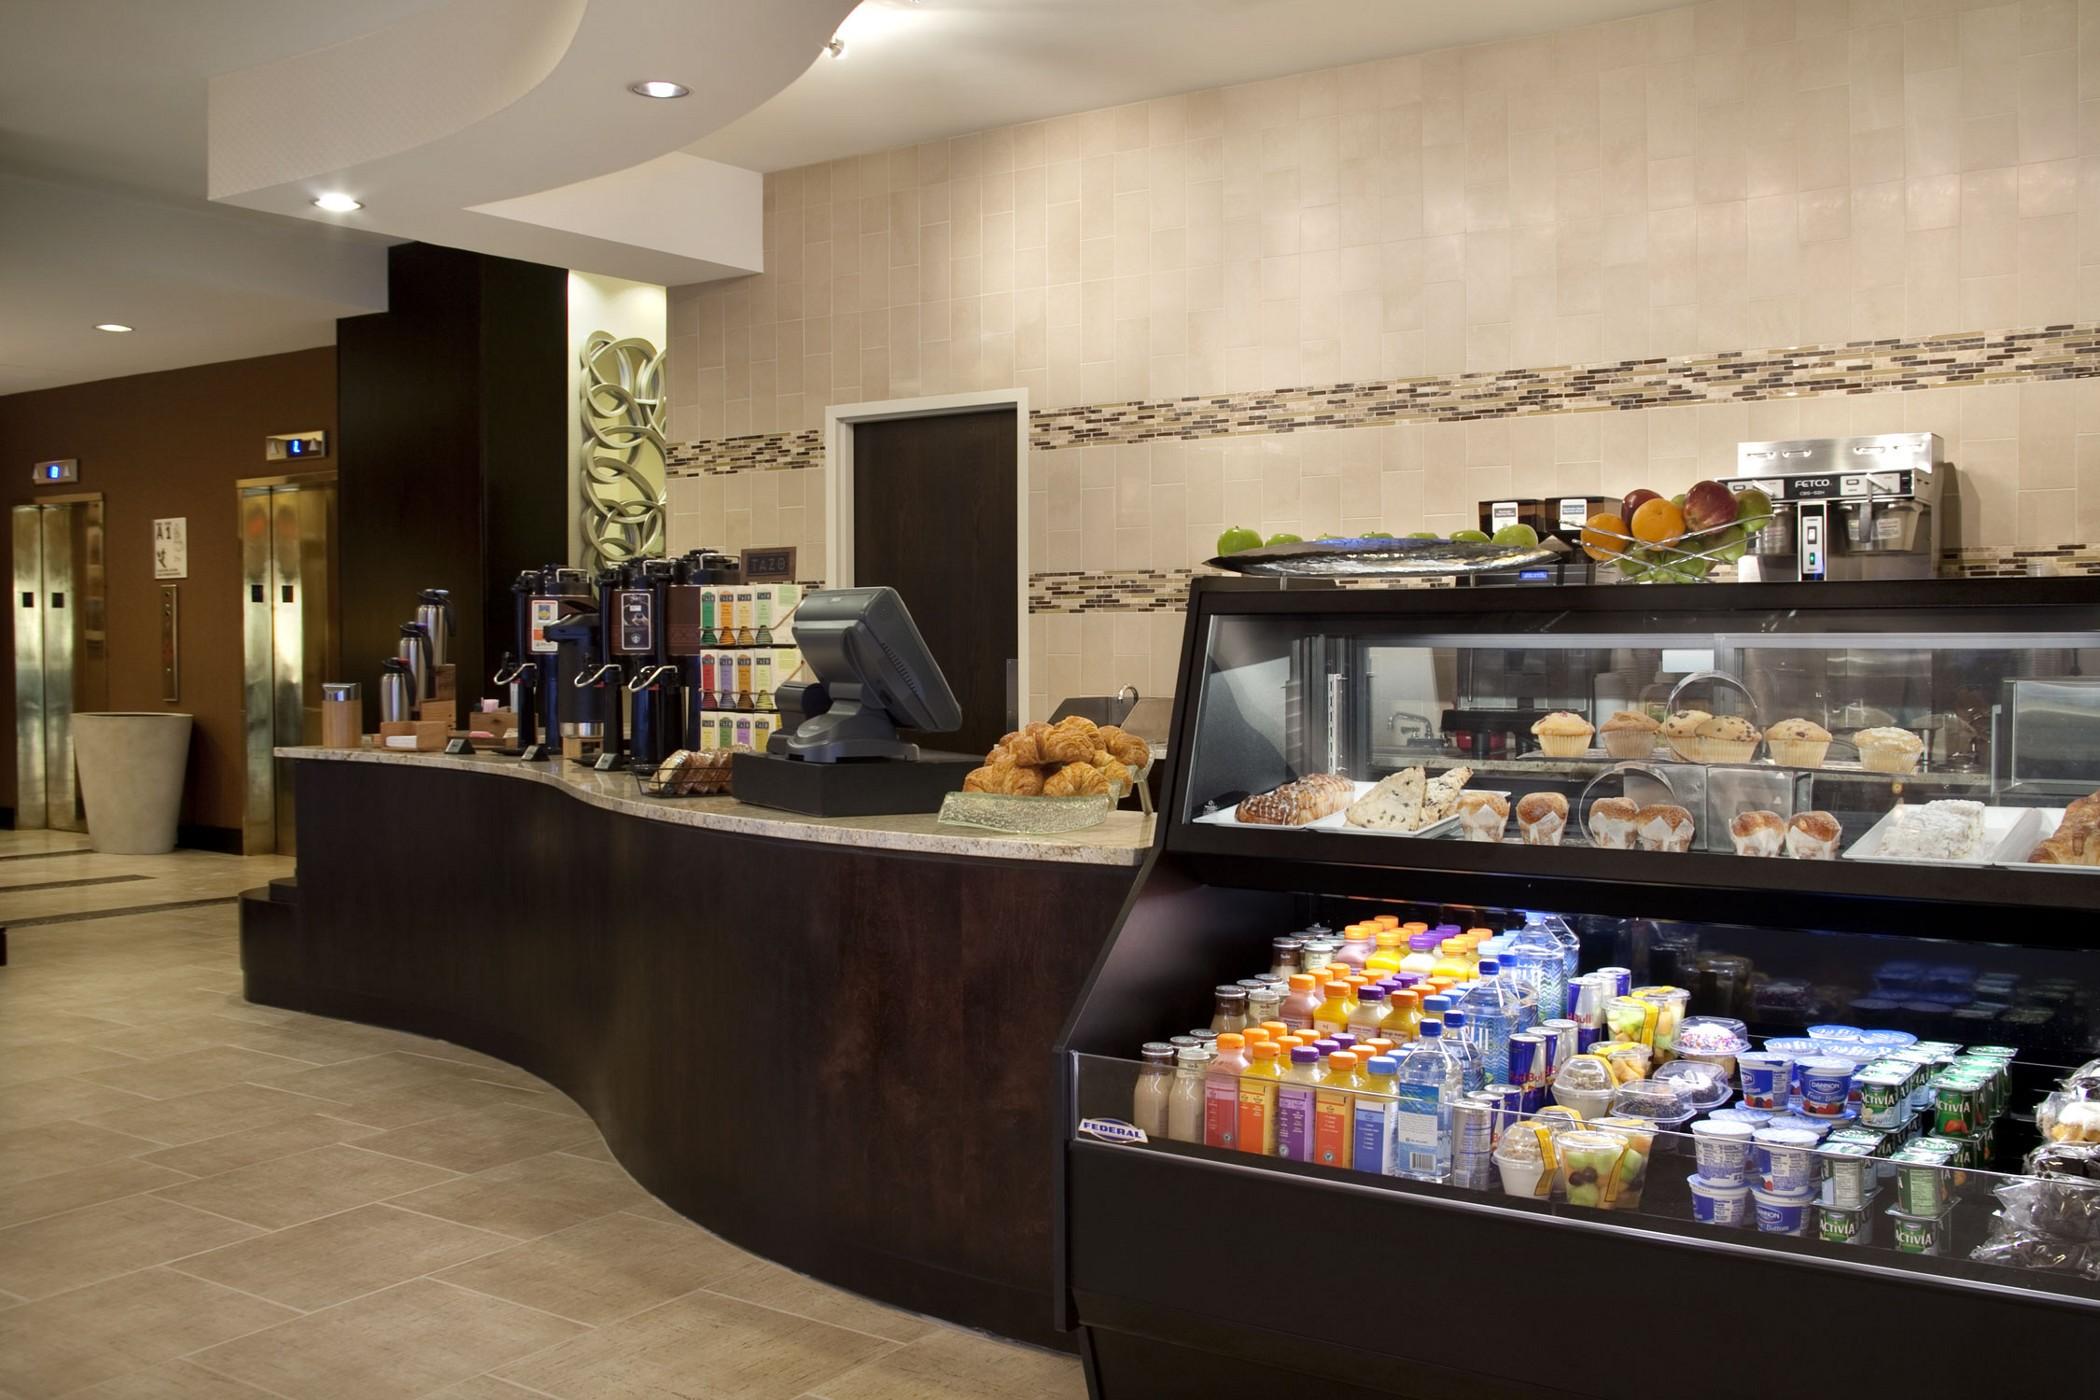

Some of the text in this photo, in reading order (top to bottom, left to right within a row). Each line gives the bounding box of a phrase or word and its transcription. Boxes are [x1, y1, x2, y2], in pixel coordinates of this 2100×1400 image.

[1794, 479, 1830, 488] FETCO
[156, 526, 164, 540] A
[1811, 1081, 1840, 1089] DANNON
[1084, 1122, 1142, 1138] FEDERAL
